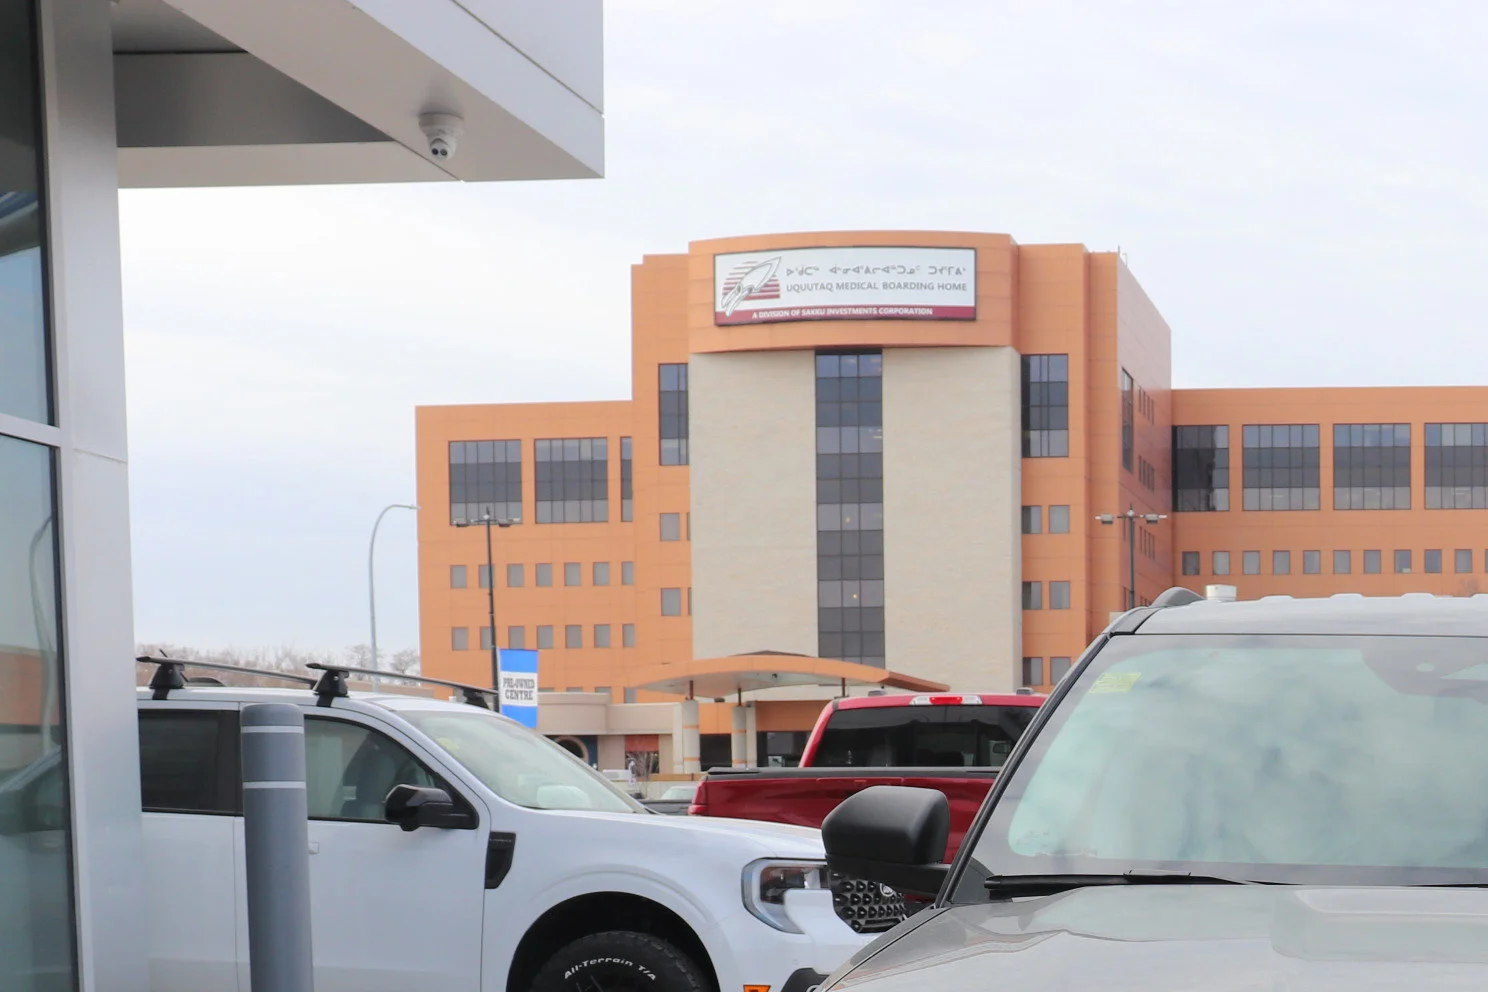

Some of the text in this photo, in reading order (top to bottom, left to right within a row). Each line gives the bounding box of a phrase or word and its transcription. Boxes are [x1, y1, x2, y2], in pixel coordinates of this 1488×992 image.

[786, 281, 968, 293] UQUUTAQ MEDICAL BOARDING HOME
[759, 310, 789, 318] DIVISION
[826, 307, 878, 316] INVESTMENTS
[878, 307, 933, 316] CORPORATION
[503, 678, 535, 689] PRE-OWNED
[505, 690, 533, 700] CENTRE
[564, 957, 657, 981] All-Terrain T/A
